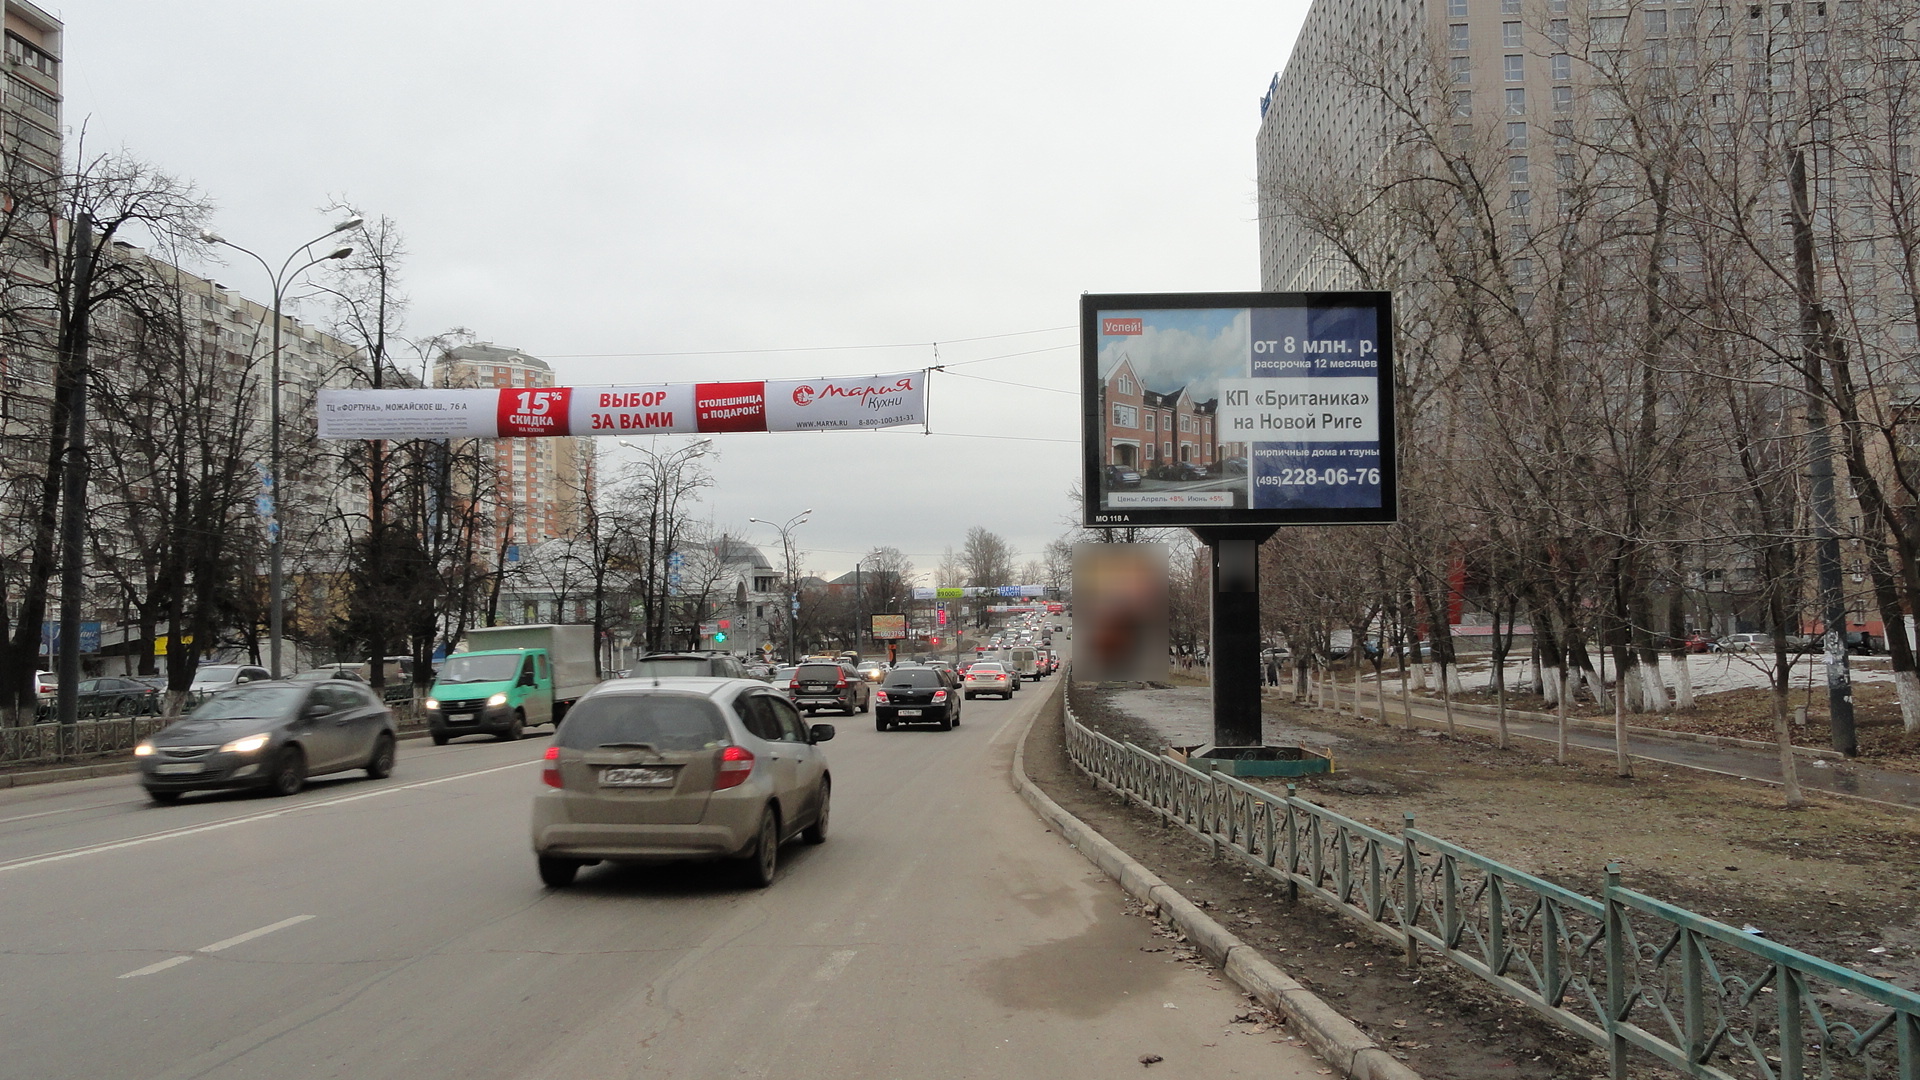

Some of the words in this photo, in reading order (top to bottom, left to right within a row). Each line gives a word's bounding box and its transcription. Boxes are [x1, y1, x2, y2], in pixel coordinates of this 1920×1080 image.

[1105, 321, 1141, 332] Успей!
[1253, 340, 1278, 354] от
[1283, 336, 1296, 354] 8
[1302, 340, 1352, 354] млн.
[1360, 339, 1378, 357] р.
[1254, 360, 1311, 370] рассрочка
[1314, 359, 1327, 368] 12
[1330, 360, 1378, 369] месяцев
[599, 391, 667, 408] ВЫБОР
[698, 394, 763, 408] СТОЛЕШНИЦА
[867, 396, 903, 412] Кухни
[1226, 390, 1249, 406] КП
[1255, 389, 1369, 410] «Британика»
[326, 404, 336, 412] ТЦ
[337, 403, 383, 412] «ФОРТУНА»,
[385, 402, 434, 411] МОЖАЙСКОЕ
[509, 414, 555, 427] СКИДКА
[591, 413, 616, 430] ЗА
[619, 412, 673, 429] ВАМИ
[796, 420, 848, 428] WWW.MARYA.RU
[858, 414, 915, 426] 8-800-100-31-31
[1233, 417, 1254, 430] на
[1260, 412, 1316, 430] Новой
[1322, 413, 1363, 429] Риге
[1255, 449, 1309, 458] кирпичные
[1311, 449, 1337, 458] дома
[1348, 449, 1379, 458] тауны
